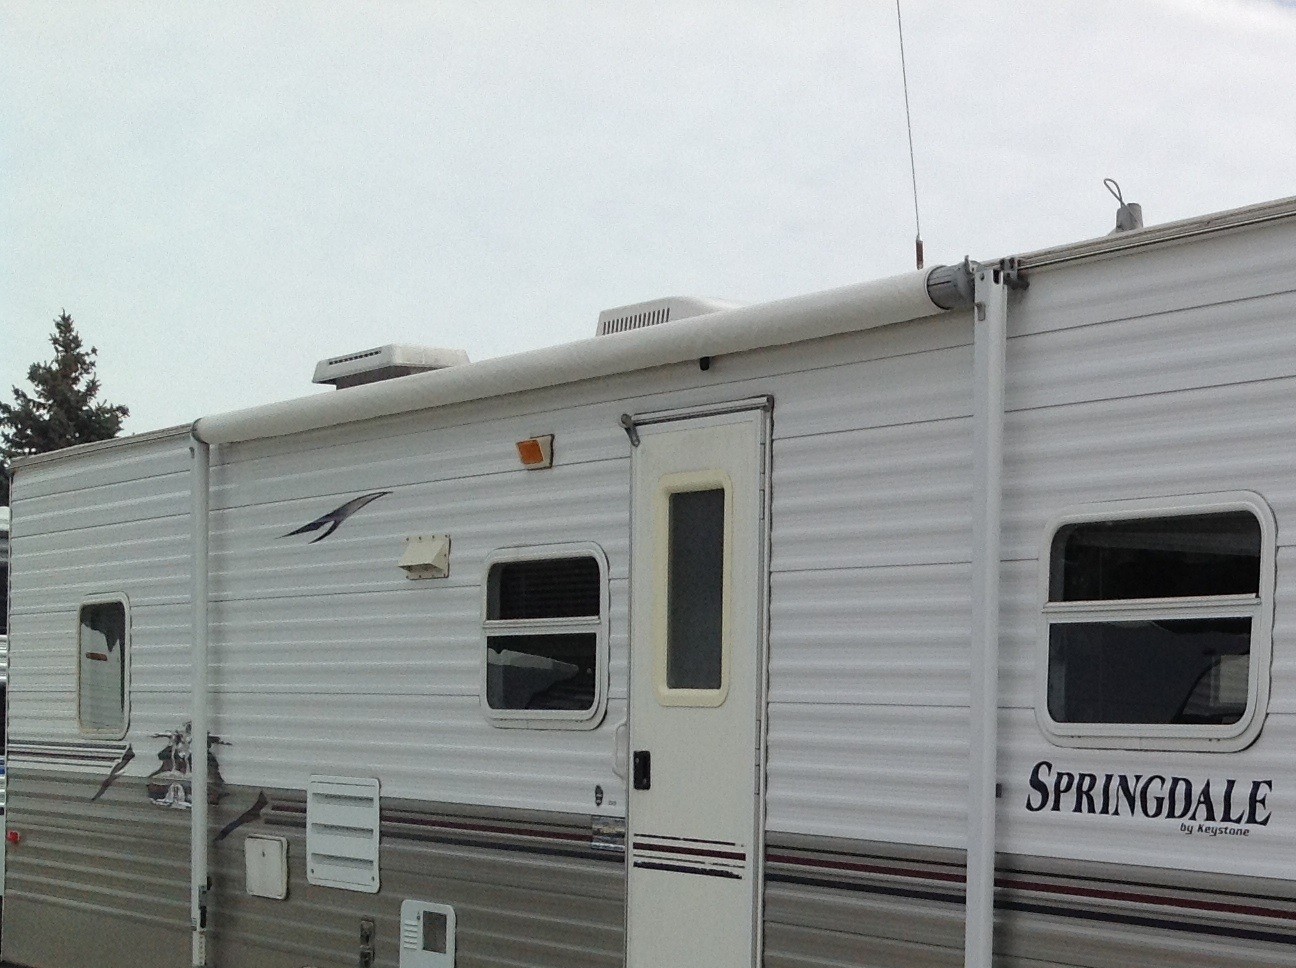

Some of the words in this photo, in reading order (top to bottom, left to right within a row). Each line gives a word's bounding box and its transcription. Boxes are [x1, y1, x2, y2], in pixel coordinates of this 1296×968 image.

[1025, 760, 1273, 826] SPRINGDALE
[1180, 822, 1194, 835] by
[1197, 823, 1250, 837] Keystone
